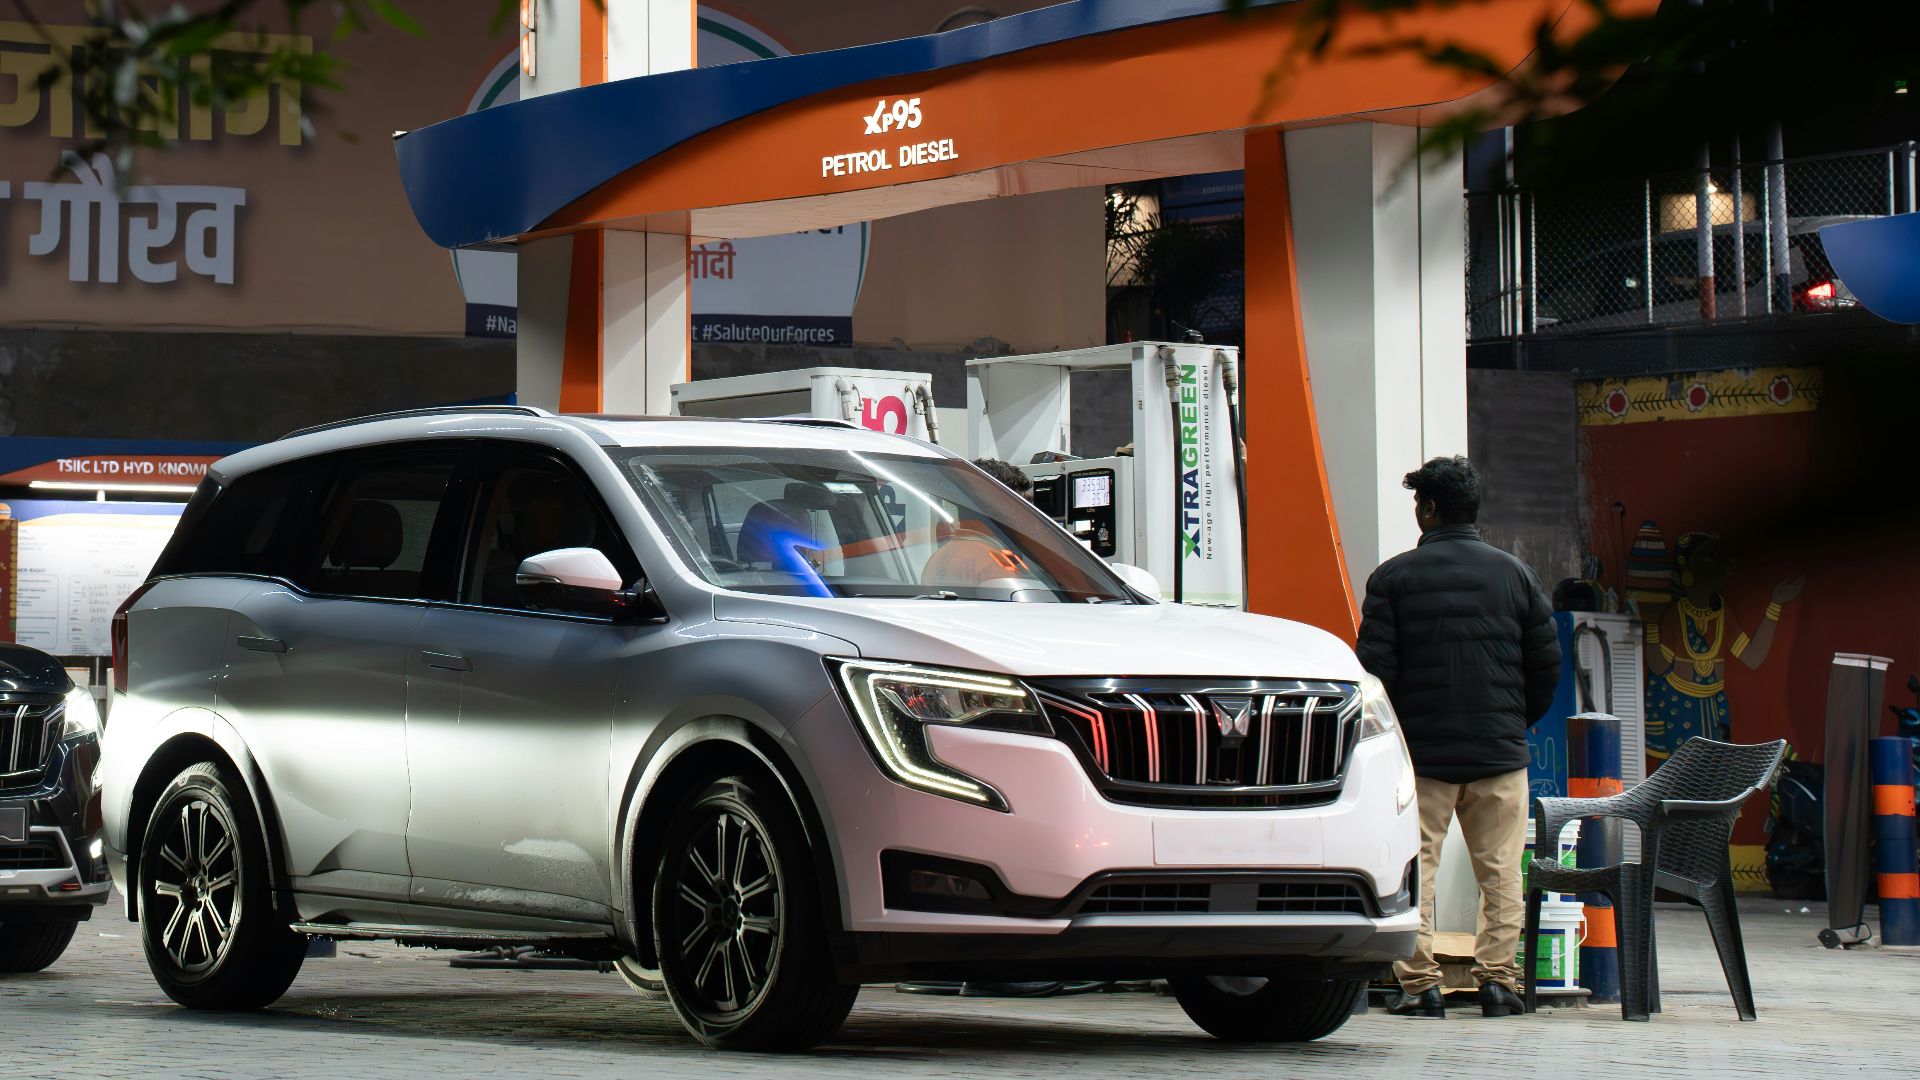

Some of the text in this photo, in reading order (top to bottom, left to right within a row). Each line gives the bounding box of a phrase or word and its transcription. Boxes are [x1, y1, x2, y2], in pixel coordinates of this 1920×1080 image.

[863, 97, 923, 135] XP95
[822, 138, 959, 177] PETROL DIESEL
[702, 324, 835, 343] #SaluteOurForces
[1202, 404, 1211, 477] performance
[57, 458, 91, 473] TSIIC
[94, 459, 119, 474] LTD
[123, 460, 154, 475] HYD
[1180, 364, 1201, 560] XTRAGREEN
[1204, 482, 1212, 507] high
